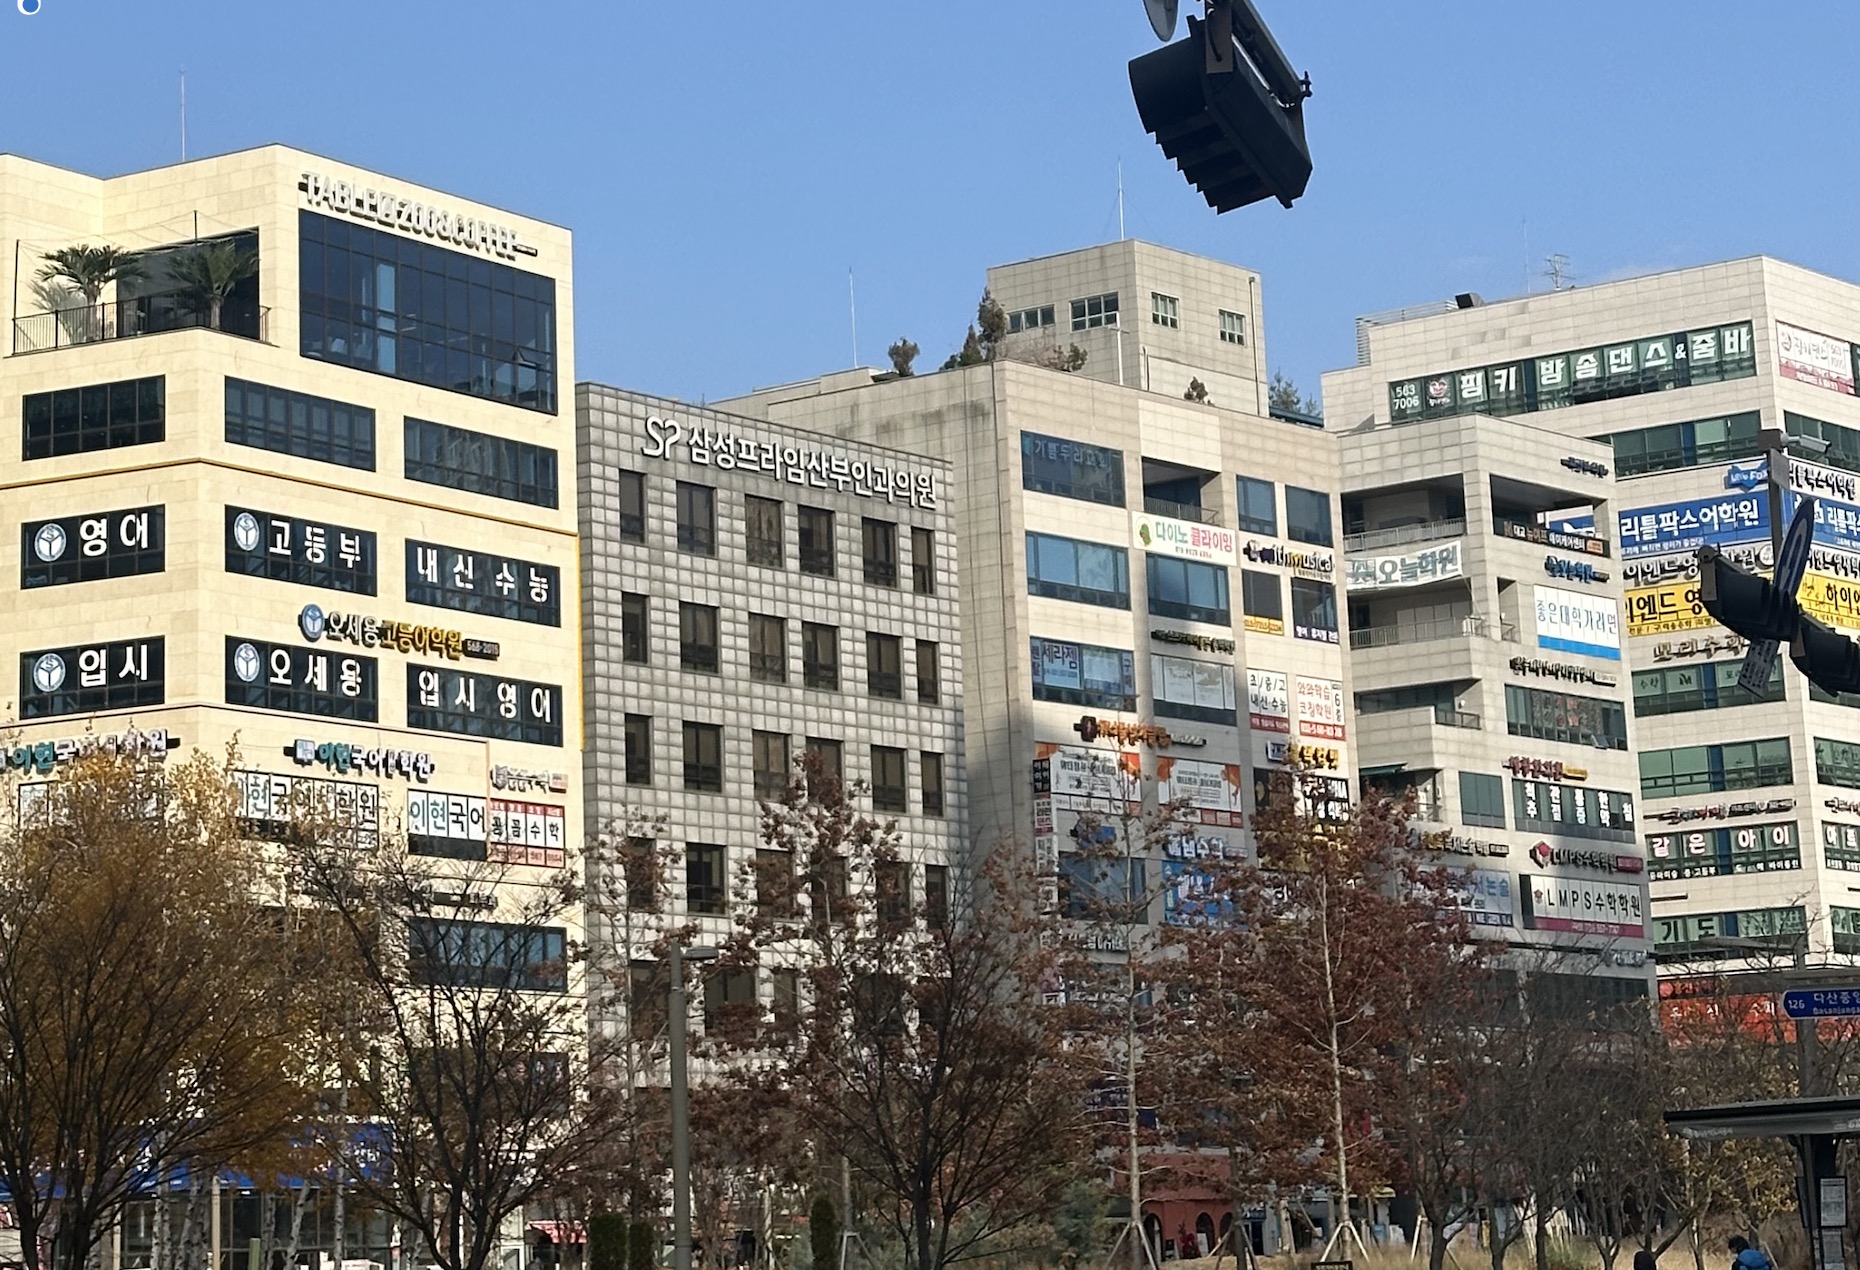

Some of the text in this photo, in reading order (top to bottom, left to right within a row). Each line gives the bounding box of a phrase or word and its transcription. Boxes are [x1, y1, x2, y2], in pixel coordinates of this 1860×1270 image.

[687, 427, 937, 510] 삼성프라임산부인과의원
[79, 512, 149, 557] 영어
[1155, 522, 1233, 553] 다이노 클라이밍
[1620, 499, 1759, 542] 리틀팍스어학원
[1826, 506, 1860, 537] 리틀팍
[269, 519, 362, 569] 고등부
[1378, 545, 1459, 584] 오늘학원
[1536, 600, 1617, 634] 좋은대학가려면
[78, 644, 148, 687] 입시
[269, 649, 362, 696] 오세용
[1043, 644, 1078, 669] 세라젬
[409, 797, 486, 833] 이현국어
[1652, 826, 1790, 857] 같은 아이
[1547, 888, 1641, 918] LMPS수학학원
[1787, 1000, 1806, 1010] 126
